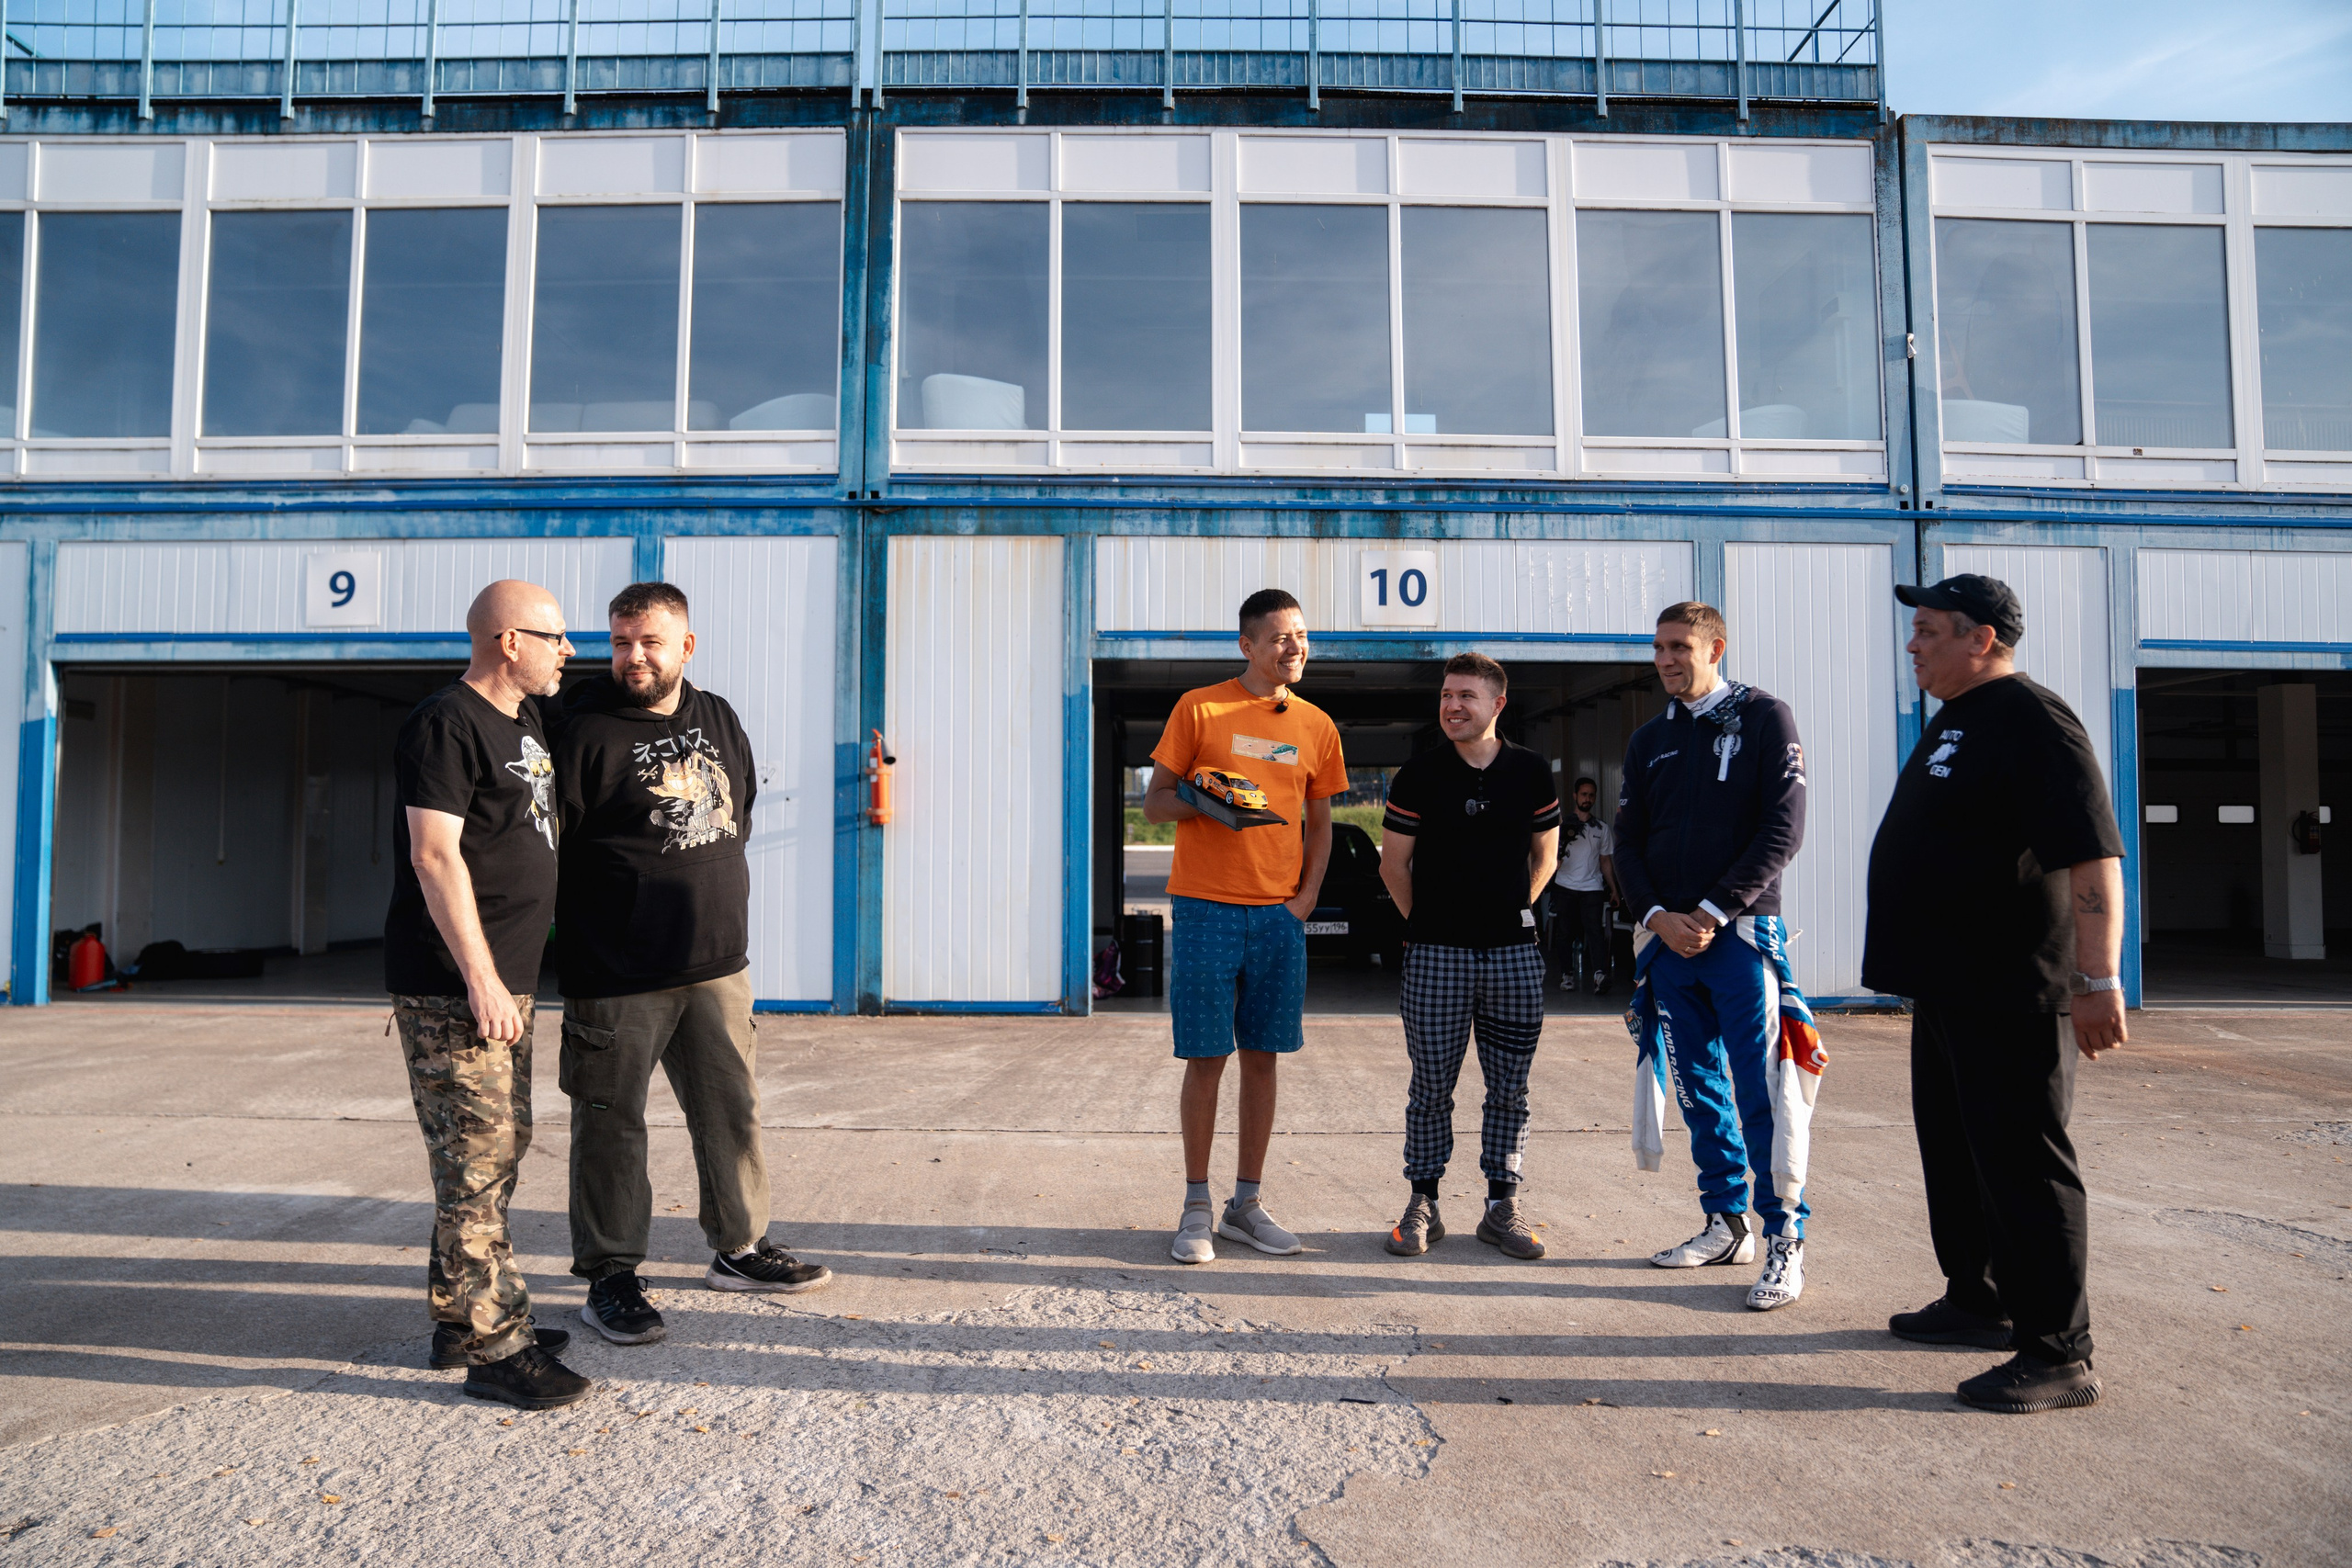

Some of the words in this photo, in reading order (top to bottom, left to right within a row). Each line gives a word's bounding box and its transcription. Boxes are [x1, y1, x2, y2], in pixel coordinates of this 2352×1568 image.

[329, 570, 356, 607] 9
[1370, 569, 1427, 606] 10
[1661, 1021, 1676, 1055] SMP
[1669, 1055, 1694, 1108] RACING
